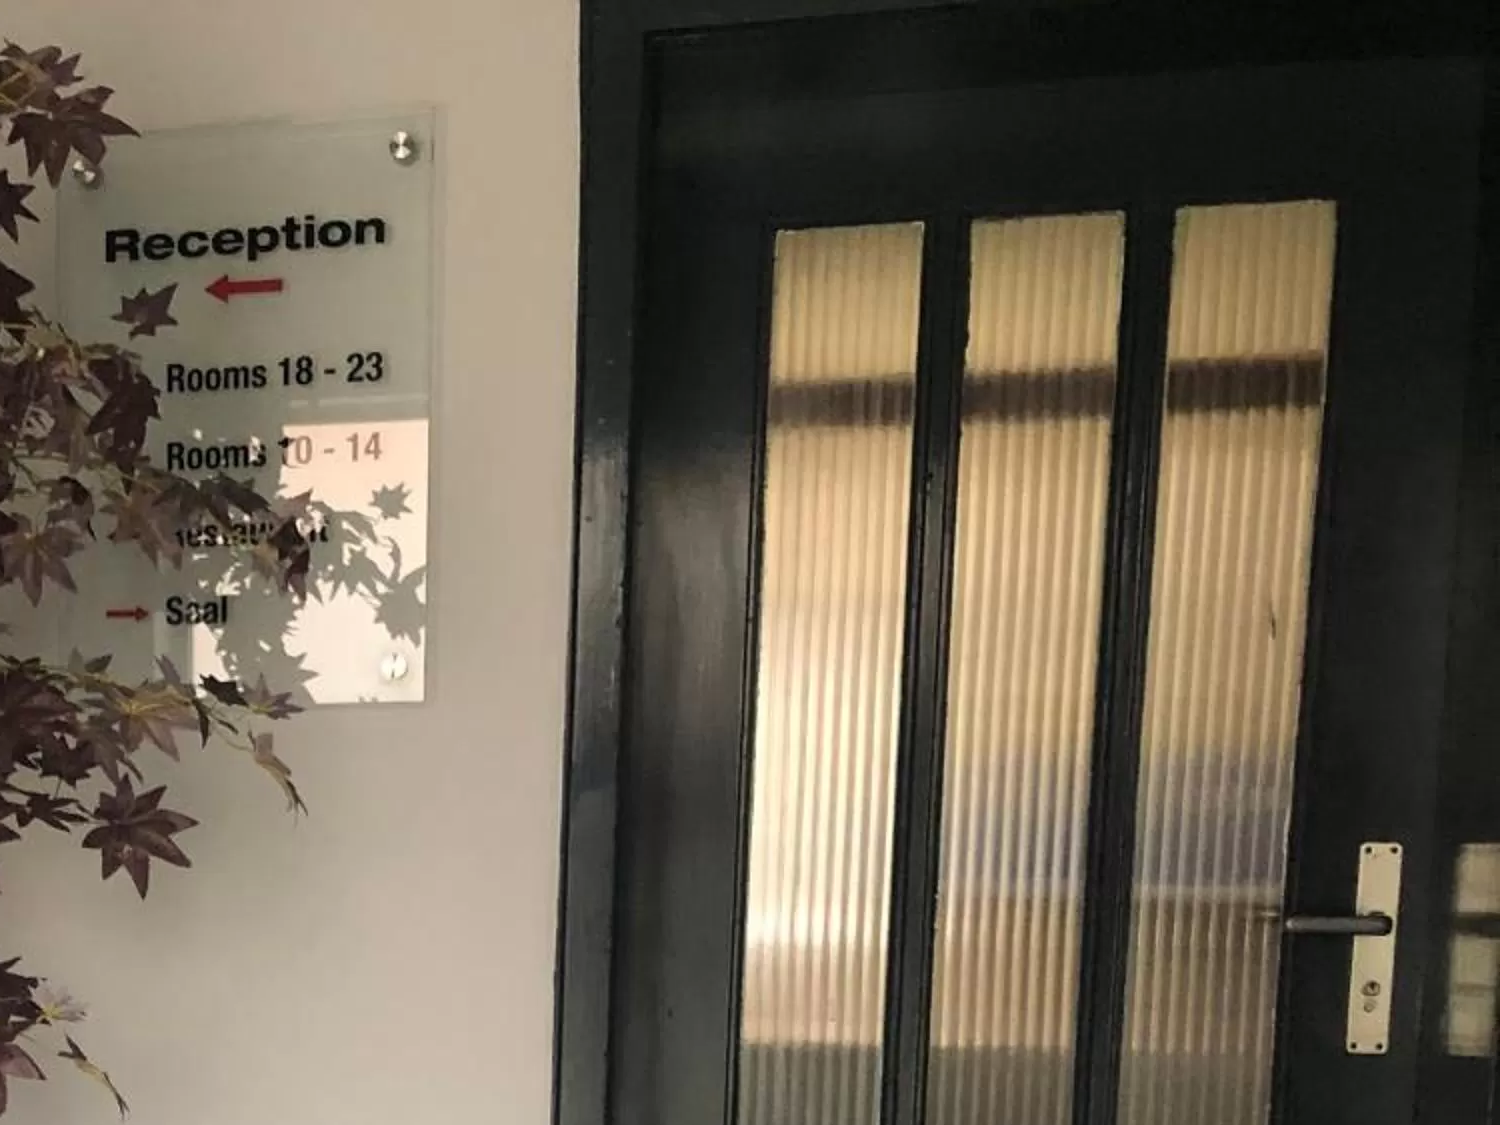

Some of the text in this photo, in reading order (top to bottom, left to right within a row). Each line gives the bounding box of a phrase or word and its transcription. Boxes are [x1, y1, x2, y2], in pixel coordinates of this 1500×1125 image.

[105, 215, 386, 262] Reception
[166, 364, 267, 393] Rooms
[278, 356, 313, 385] 18
[346, 352, 383, 382] 23
[166, 442, 267, 471] Rooms
[346, 431, 383, 462] 14
[166, 597, 228, 626] Saal
